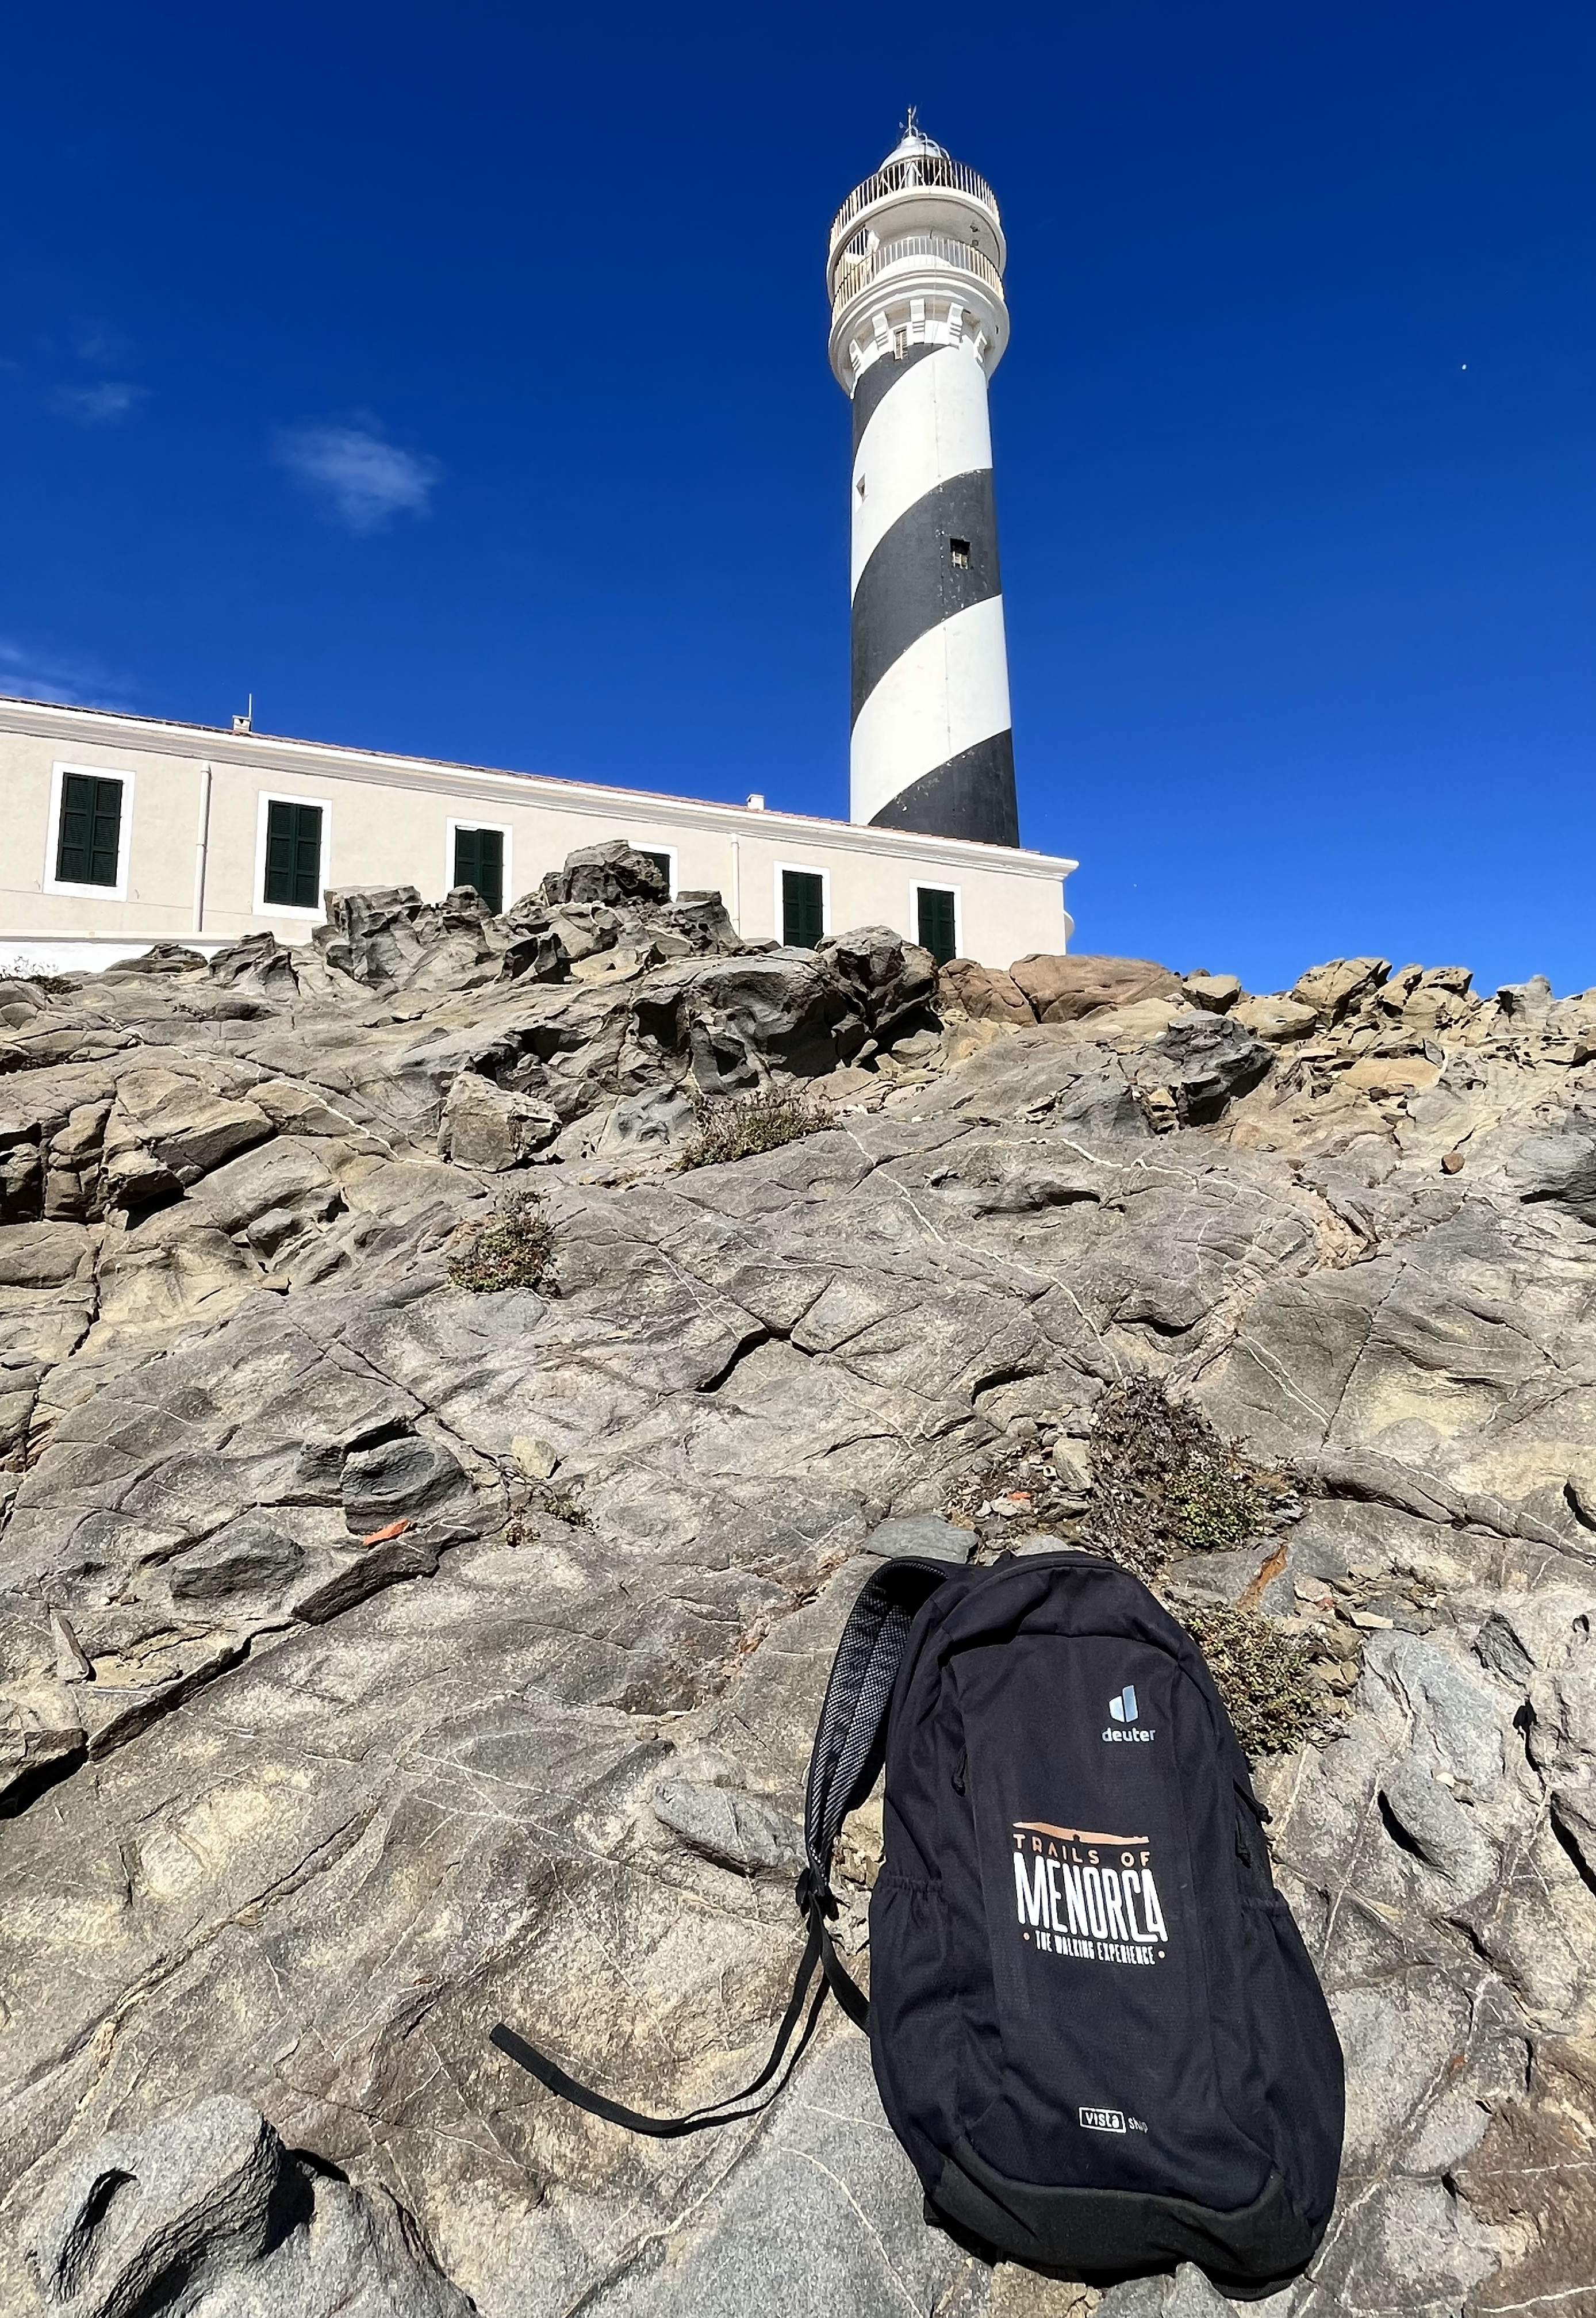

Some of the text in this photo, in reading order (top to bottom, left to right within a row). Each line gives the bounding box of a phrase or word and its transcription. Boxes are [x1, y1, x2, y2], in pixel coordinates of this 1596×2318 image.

[1102, 1727, 1156, 1742] deuter
[1012, 1834, 1150, 1867] TRAILS OF
[1012, 1852, 1168, 1942] MENORCA
[1035, 1930, 1156, 1965] THE WALKING EXPERIENCE
[1084, 2111, 1120, 2128] vista
